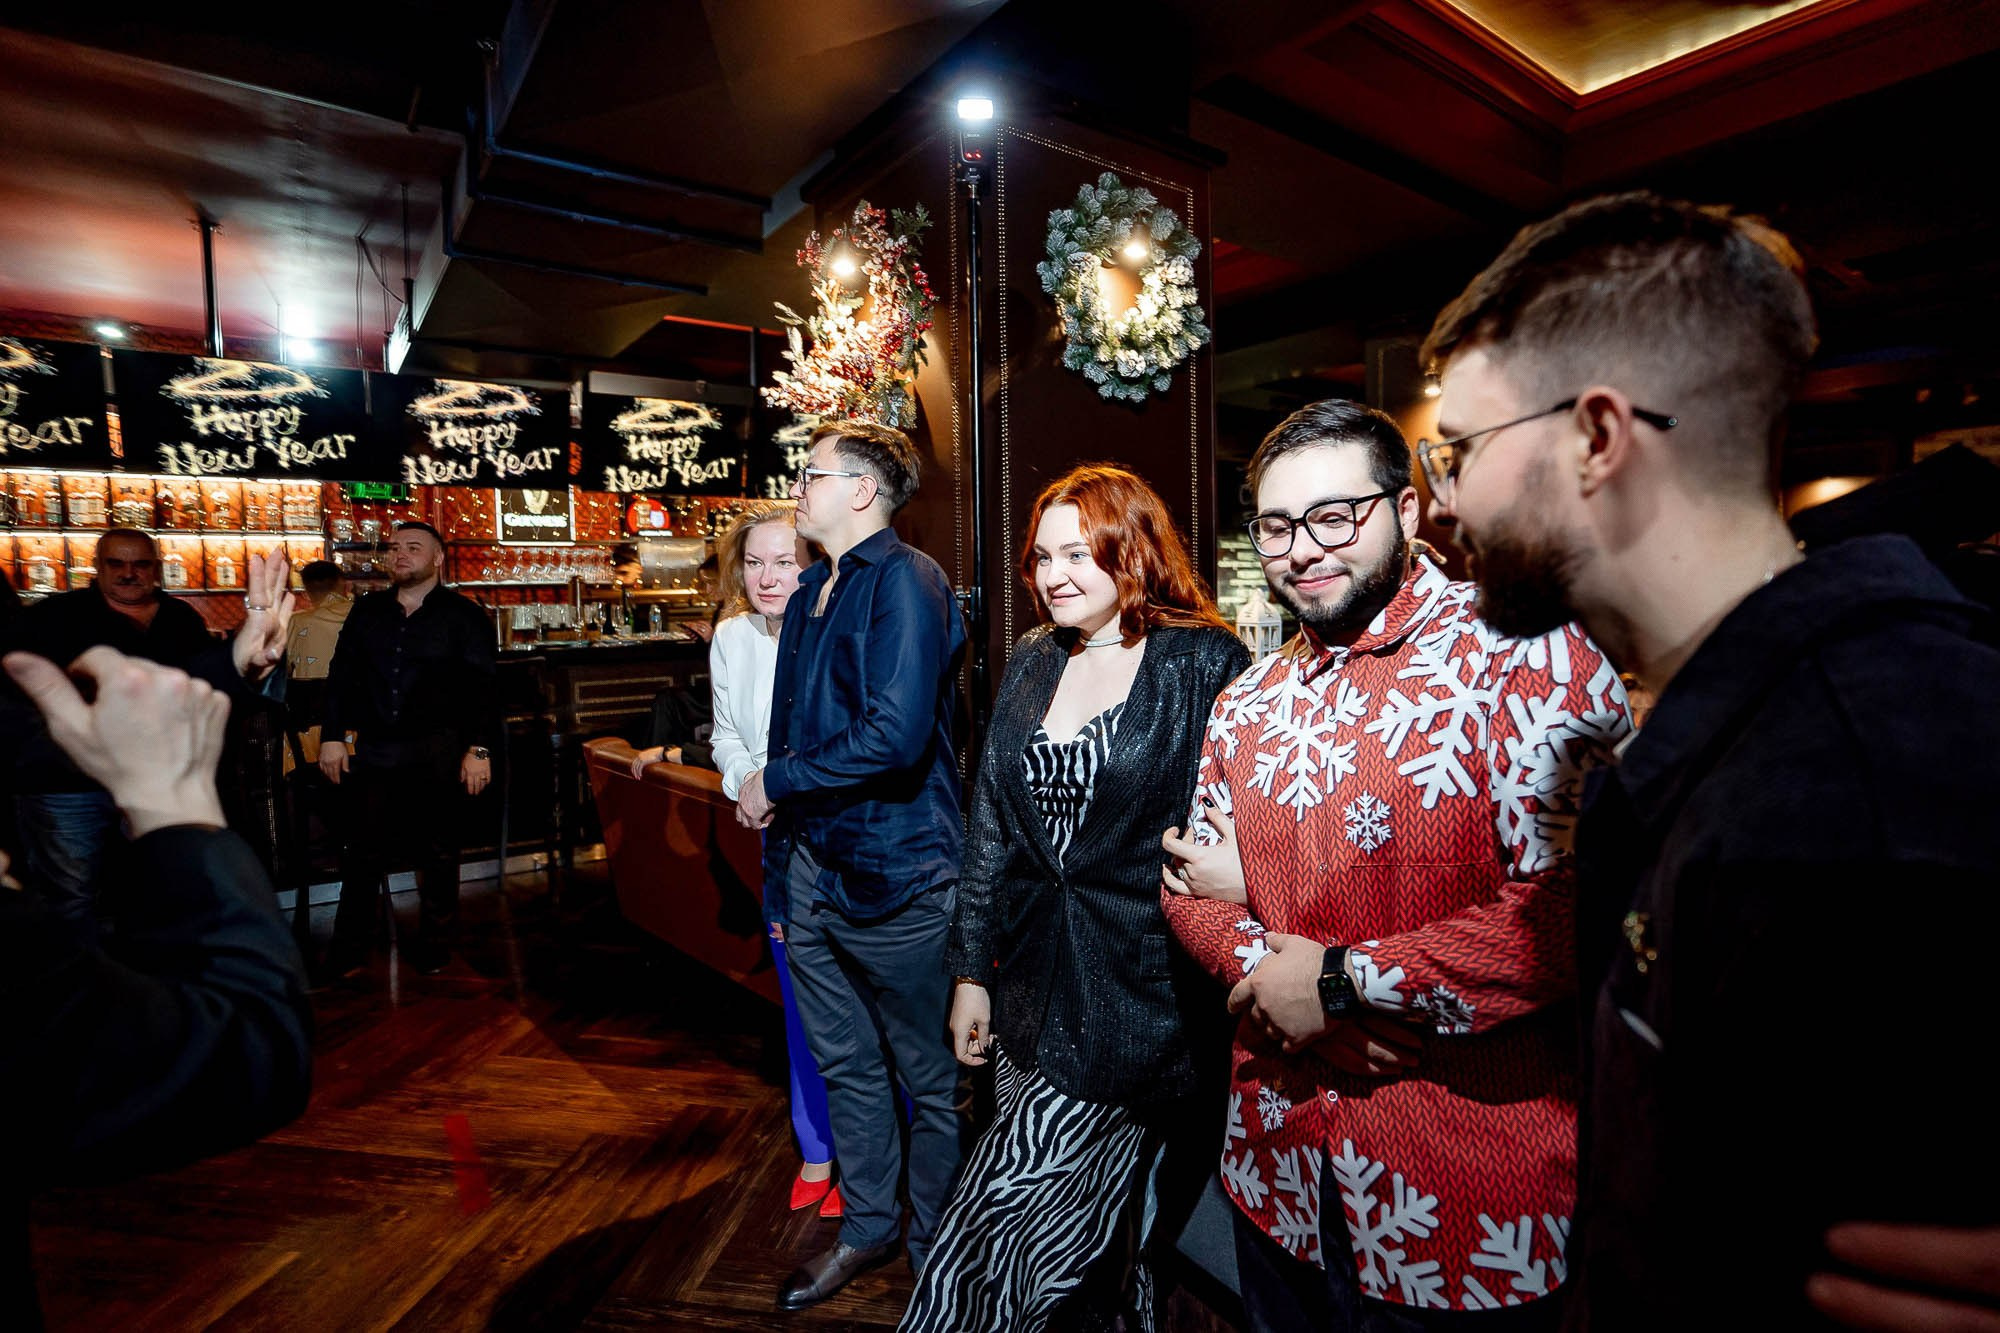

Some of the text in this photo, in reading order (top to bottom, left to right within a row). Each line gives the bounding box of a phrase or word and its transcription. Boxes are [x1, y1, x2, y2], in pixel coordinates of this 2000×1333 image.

[0, 416, 93, 455] ear
[186, 404, 306, 441] Happy
[426, 420, 521, 454] Happy
[158, 434, 356, 475] New Year
[402, 448, 560, 484] New Year
[625, 435, 704, 465] Happy
[604, 458, 736, 492] New Year
